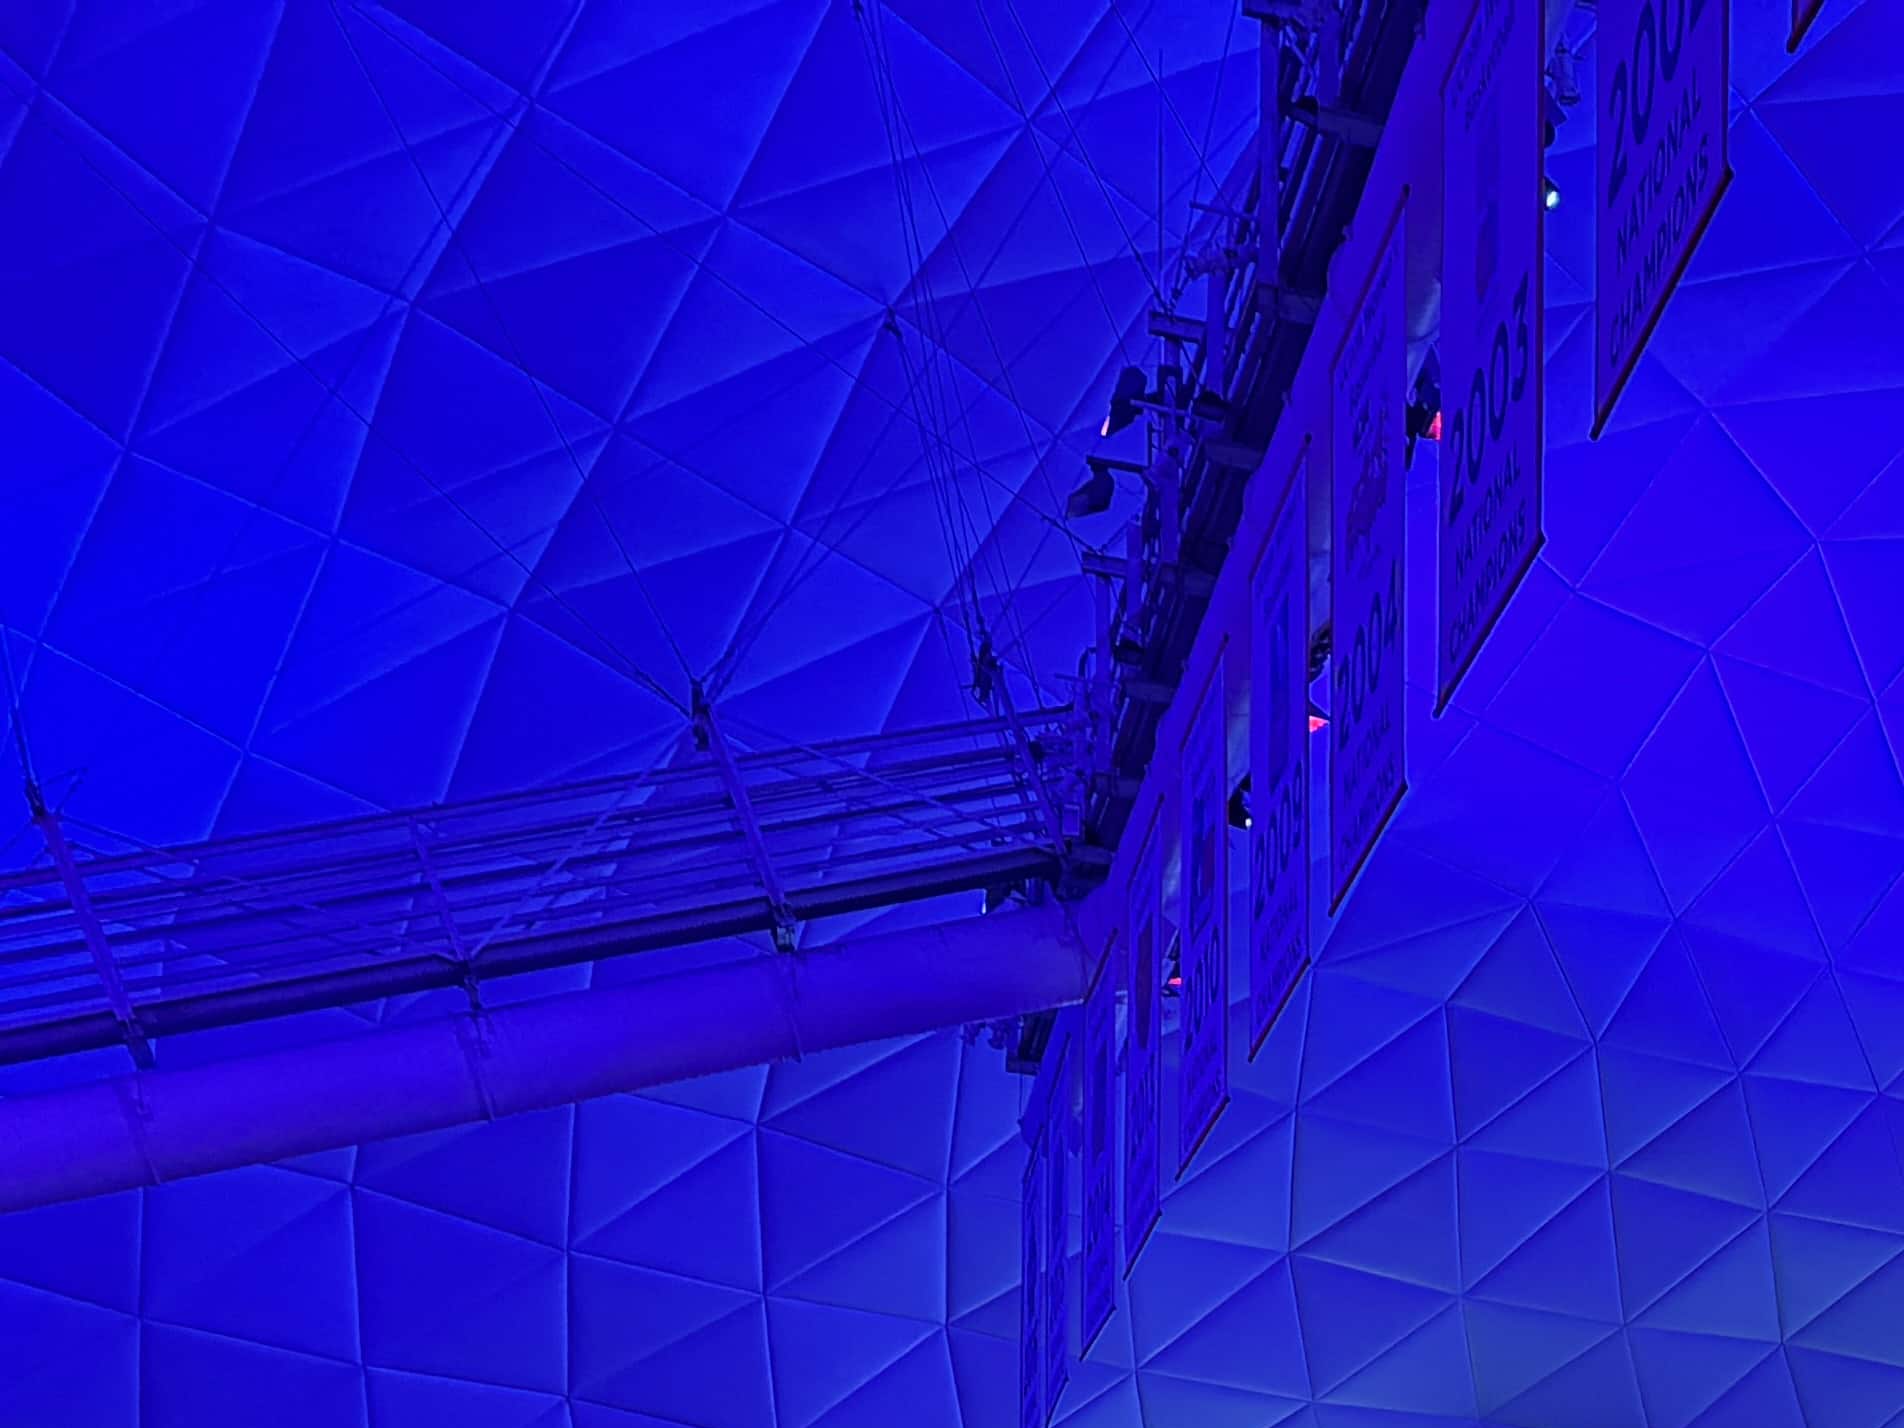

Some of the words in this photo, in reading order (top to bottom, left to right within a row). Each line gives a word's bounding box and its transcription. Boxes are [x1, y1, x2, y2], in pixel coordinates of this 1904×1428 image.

[1609, 136, 1709, 367] CHAMPIONS
[1617, 67, 1702, 271] NATIONAL
[1446, 271, 1529, 526] 2003
